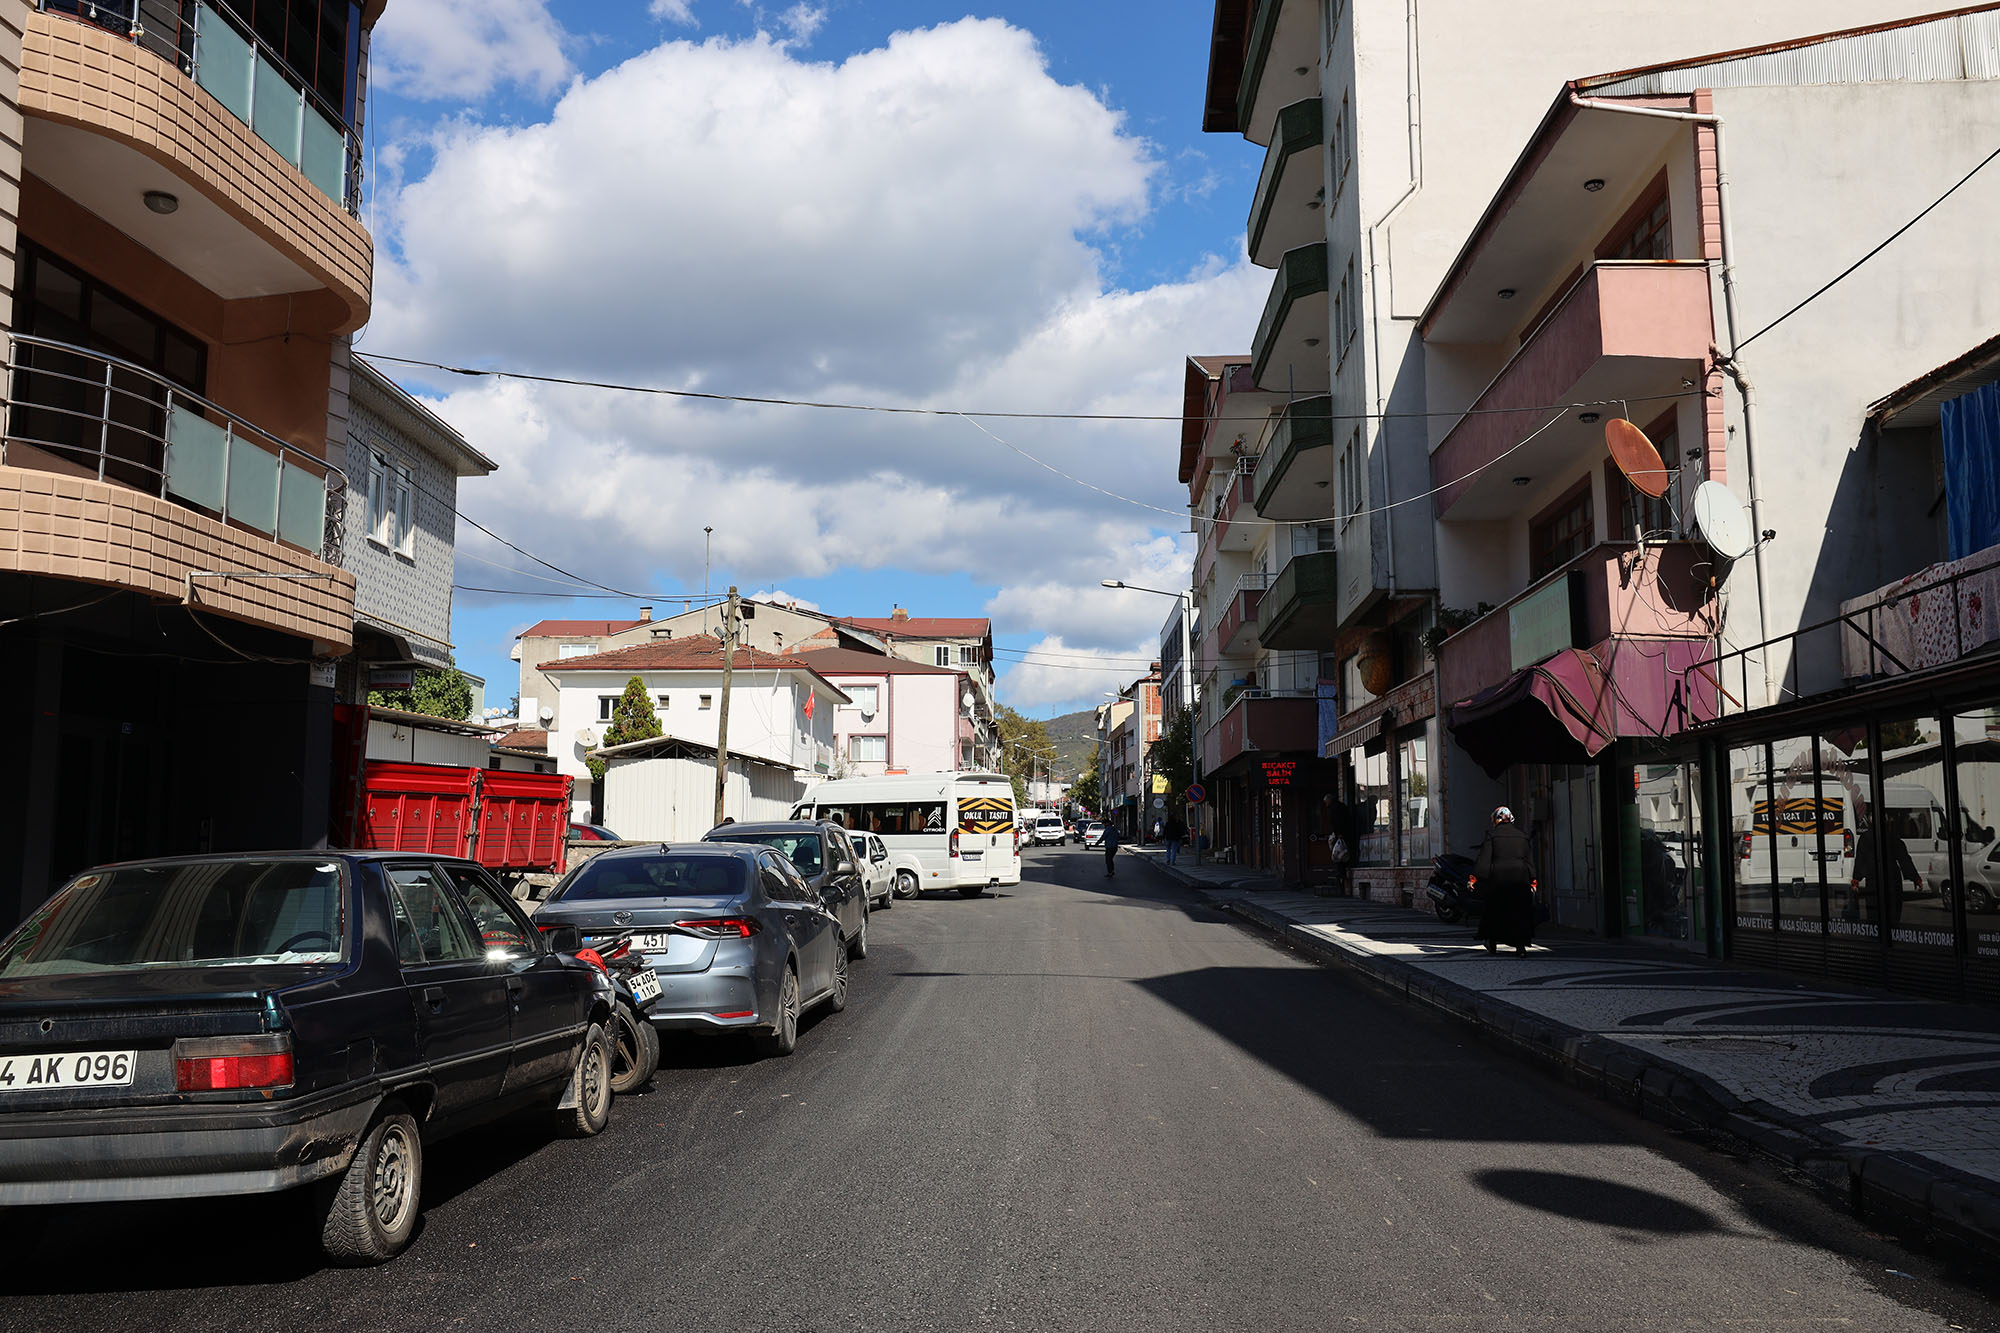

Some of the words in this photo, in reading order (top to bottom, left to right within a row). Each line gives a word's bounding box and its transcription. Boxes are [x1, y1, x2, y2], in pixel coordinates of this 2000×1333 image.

[964, 811, 983, 820] OKUL
[1737, 914, 1773, 929] DAVETİYE
[1828, 918, 1852, 935] DÜĞÜN
[643, 934, 664, 947] 451
[1891, 928, 1918, 943] KAMERA
[1918, 931, 1924, 944] &
[1978, 932, 1991, 942] HER
[1977, 946, 1999, 956] UYGUN
[630, 978, 641, 989] 54
[641, 971, 656, 985] ADE
[642, 984, 656, 998] 110
[26, 1057, 64, 1084] AK
[74, 1054, 129, 1082] 096
